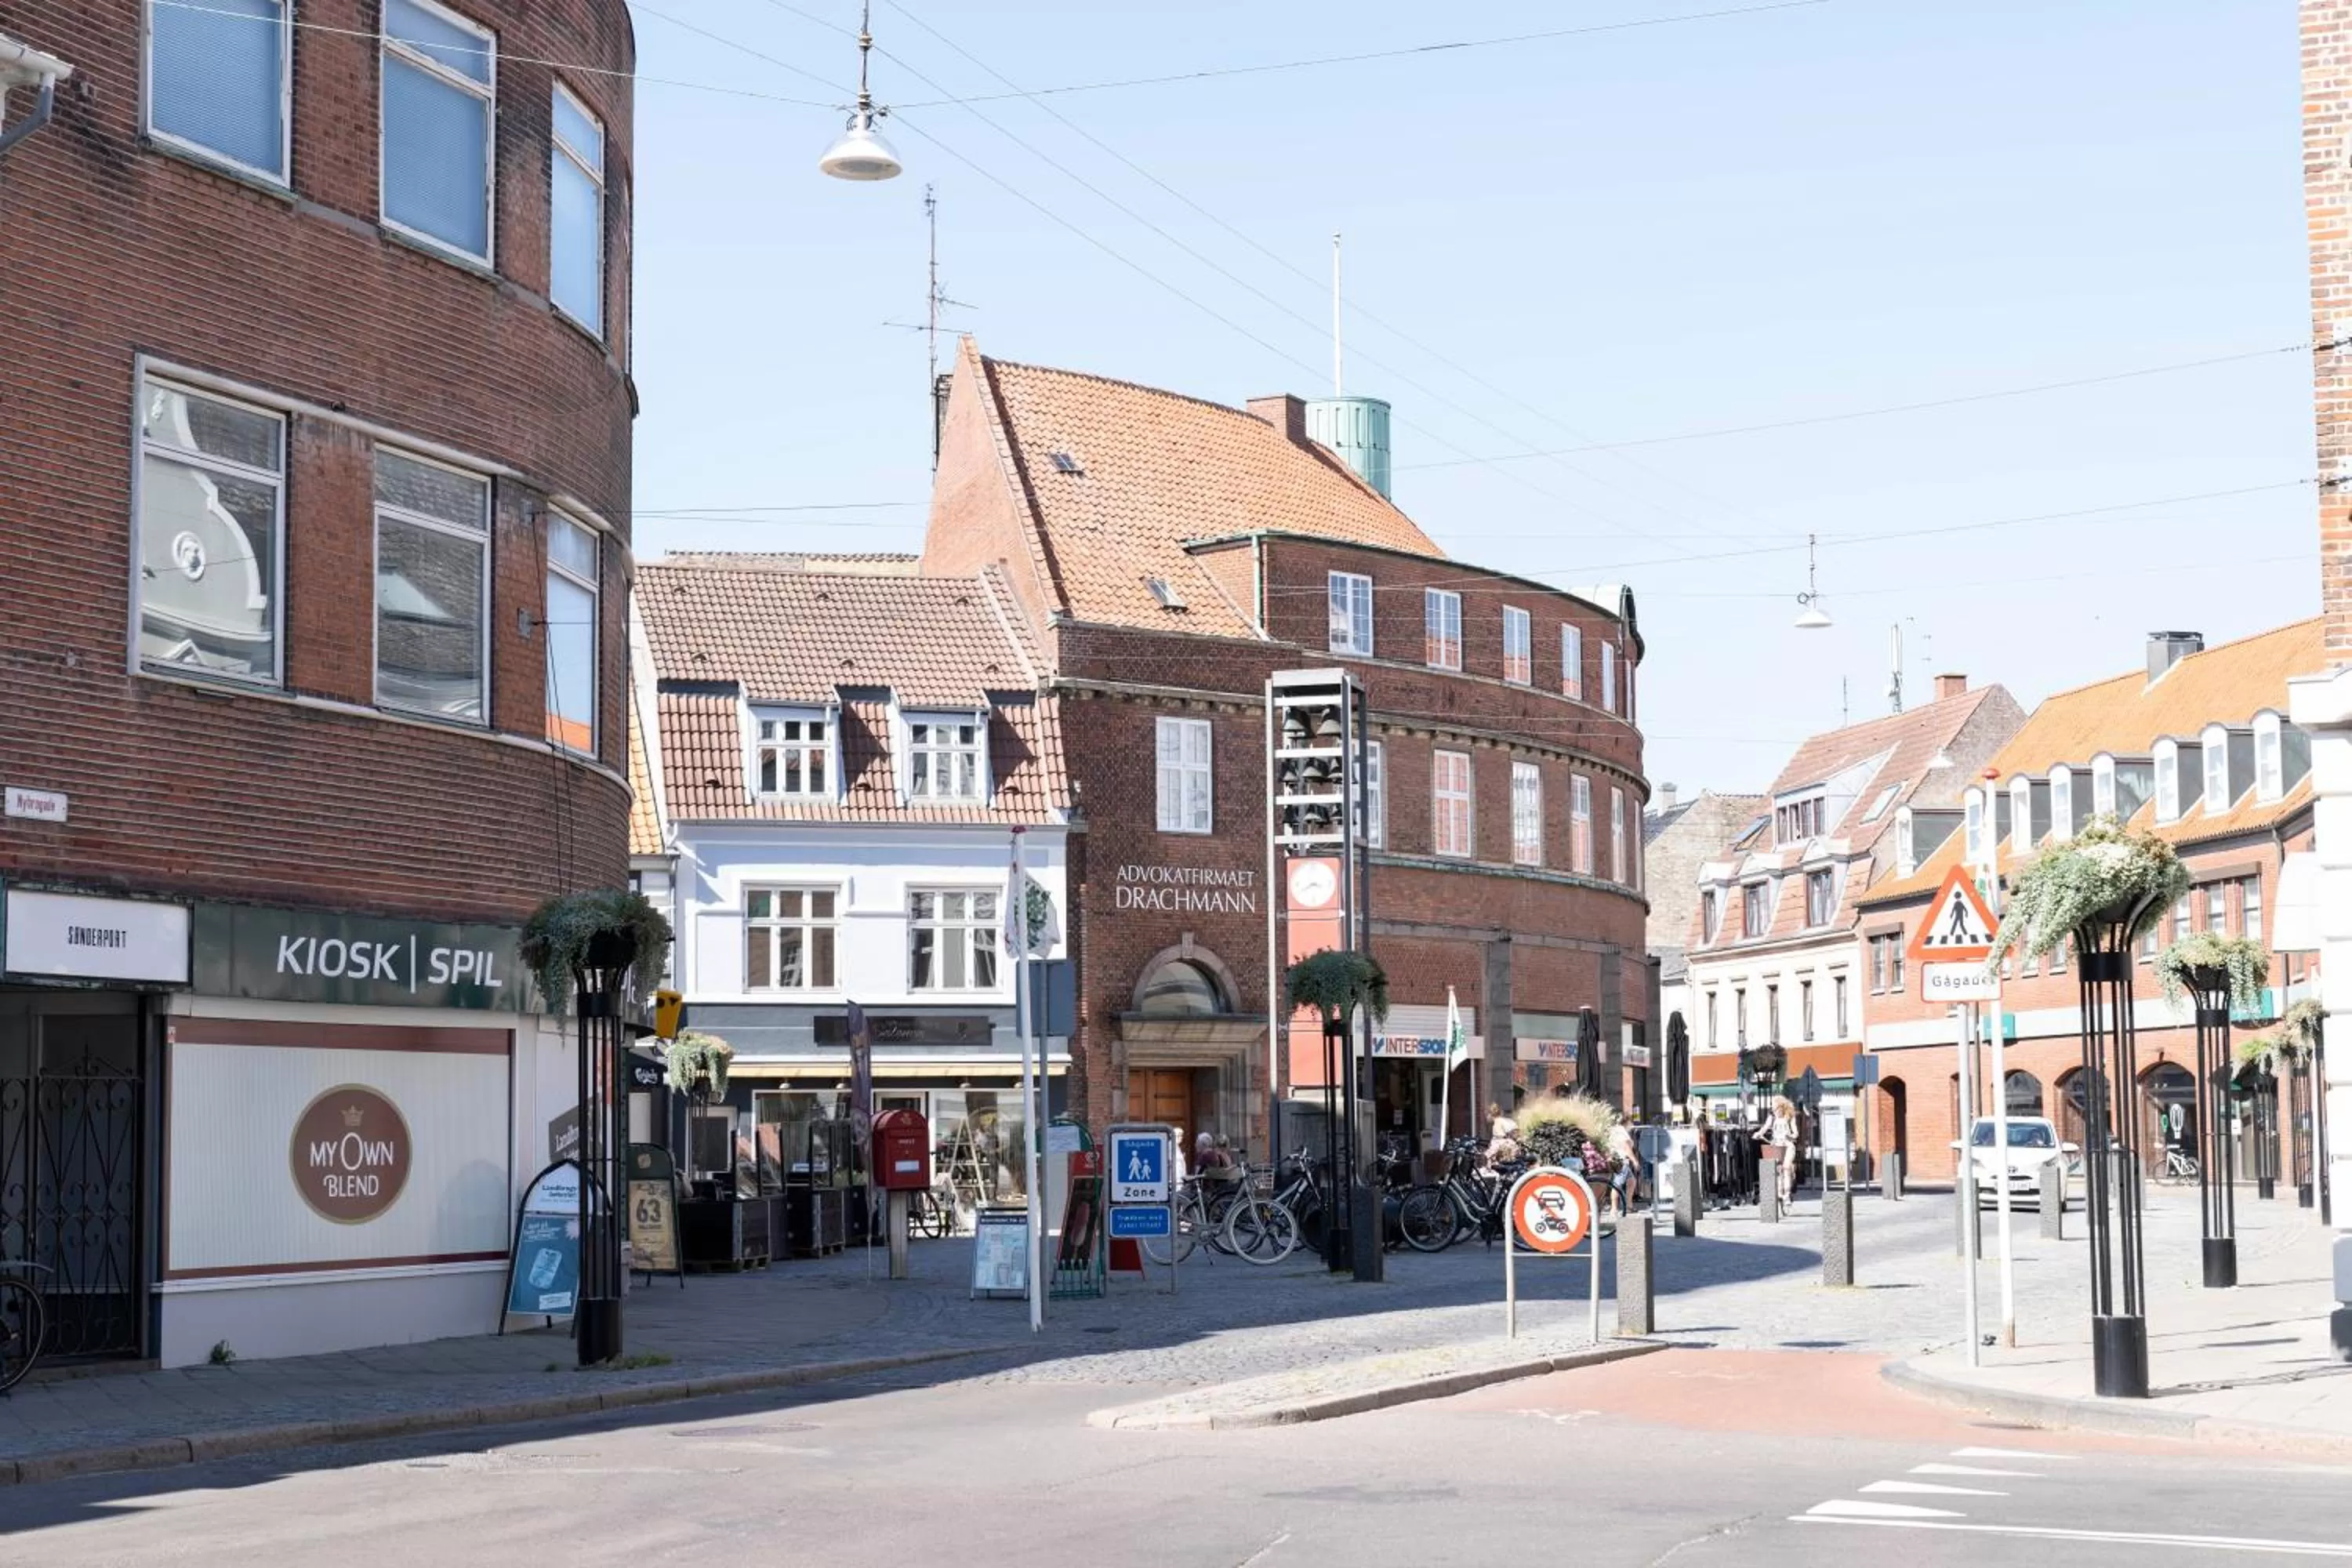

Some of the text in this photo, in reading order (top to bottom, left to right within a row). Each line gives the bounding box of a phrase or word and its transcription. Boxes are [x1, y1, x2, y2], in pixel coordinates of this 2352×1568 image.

[1116, 865, 1255, 887] ADVOKATFIRMAET
[1116, 885, 1256, 914] DRACHMANN
[277, 935, 503, 987] KIOSK SPIL
[1385, 1036, 1446, 1054] INTERSPOR
[310, 1132, 394, 1171] MY OWN
[323, 1174, 379, 1197] BLEND
[1123, 1185, 1156, 1197] Zone
[636, 1199, 662, 1223] 63
